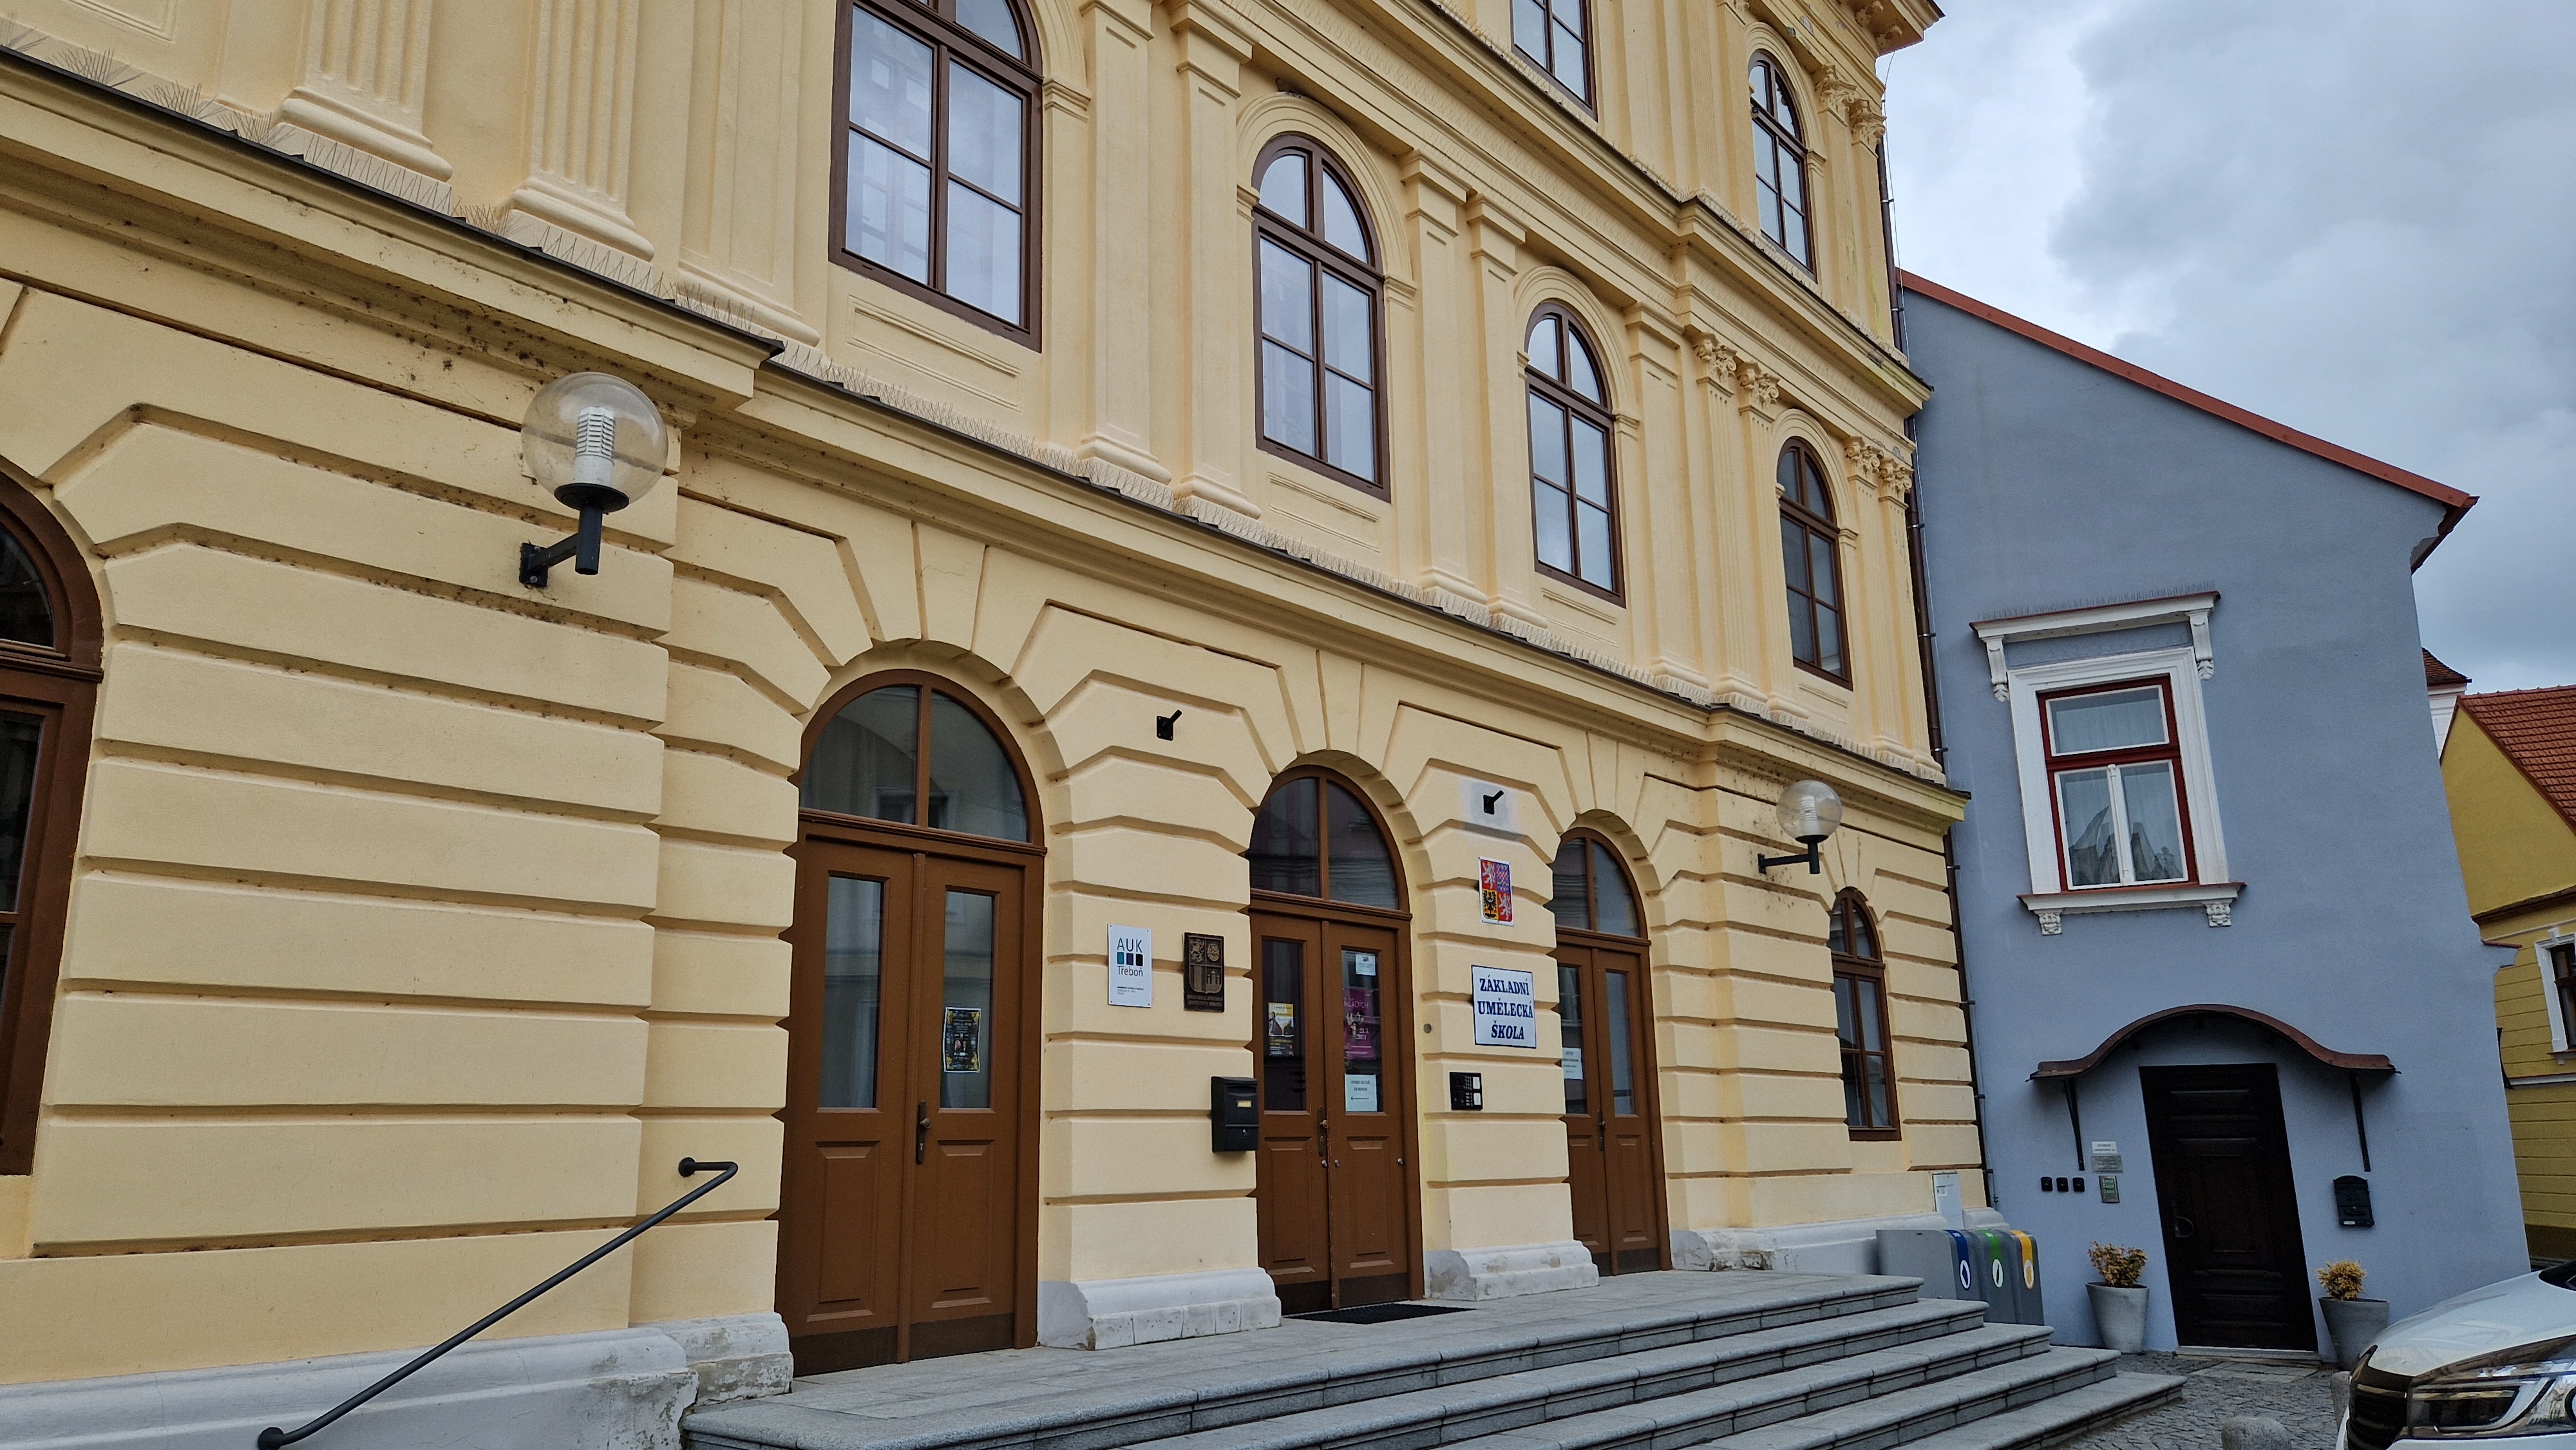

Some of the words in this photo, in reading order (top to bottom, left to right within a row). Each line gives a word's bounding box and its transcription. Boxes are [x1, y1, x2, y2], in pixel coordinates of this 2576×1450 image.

[1117, 937, 1142, 953] AUK
[1117, 966, 1143, 977] Třeboň
[1479, 974, 1530, 995] ZÁKLADNÍ
[1477, 997, 1533, 1019] UMĚLECKÁ
[1491, 1020, 1524, 1040] ŠKOLA
